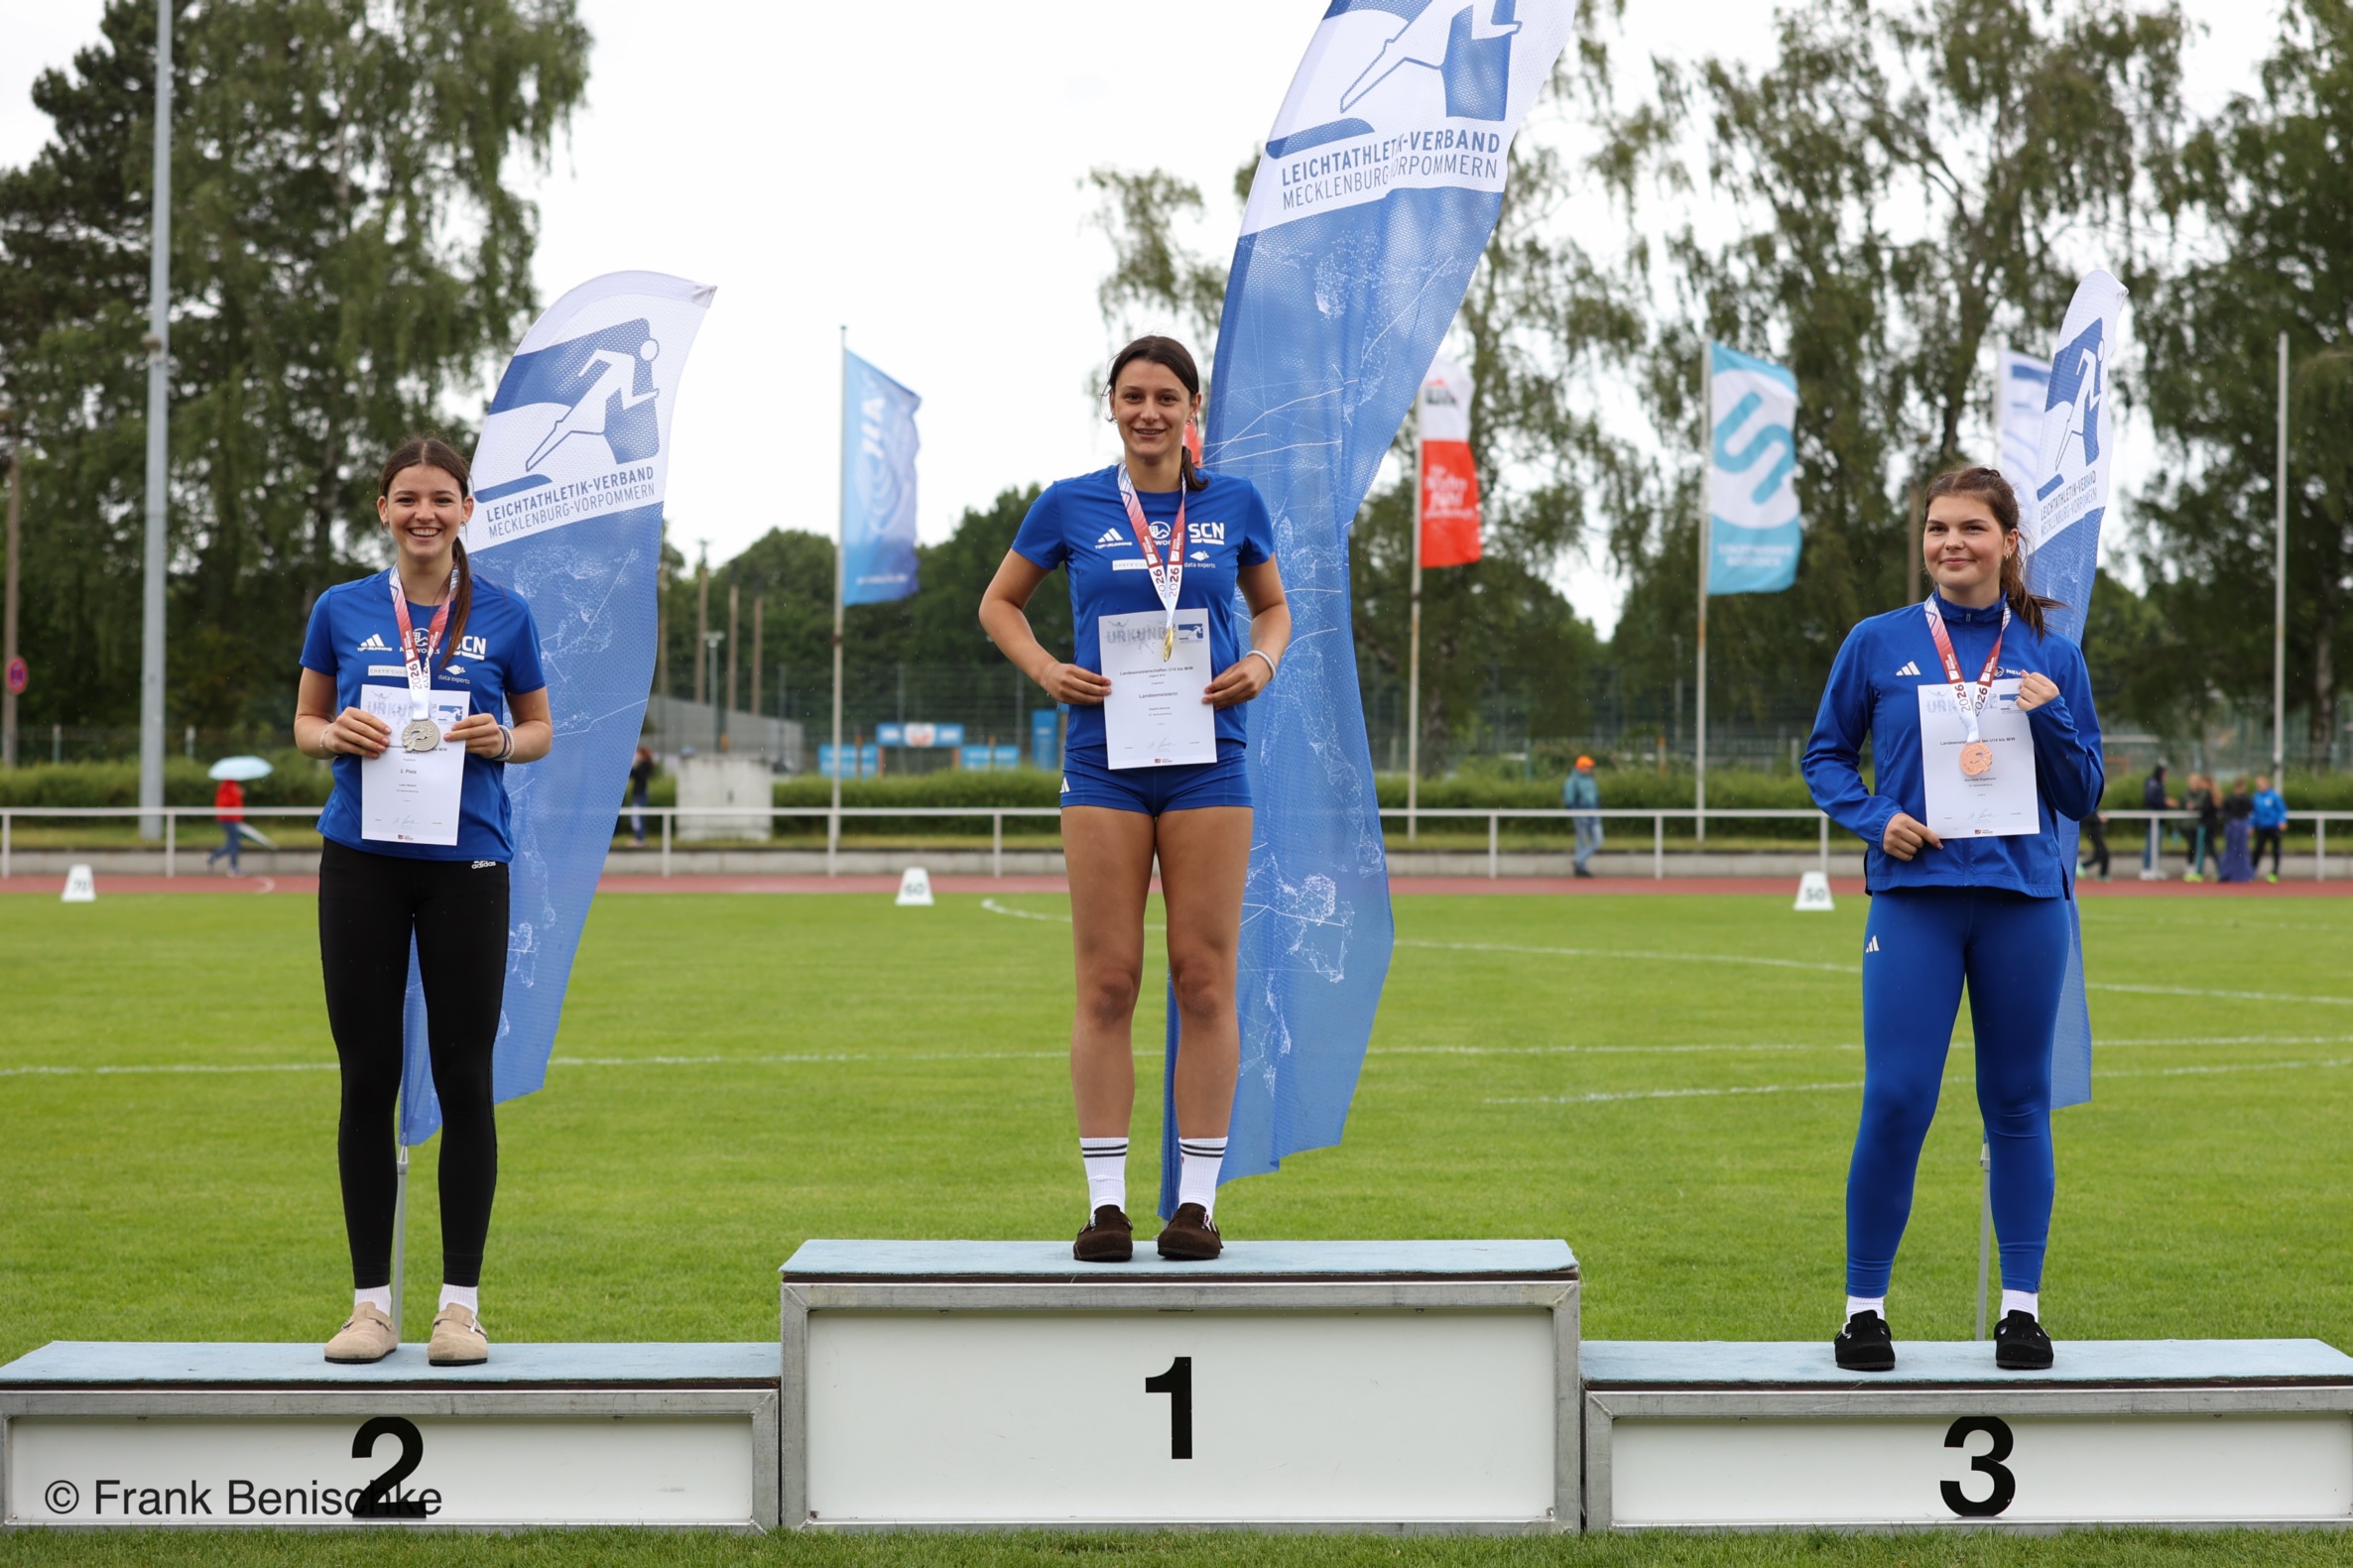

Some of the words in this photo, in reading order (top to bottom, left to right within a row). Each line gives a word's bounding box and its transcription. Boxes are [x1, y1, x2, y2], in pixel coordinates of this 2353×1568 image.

[486, 466, 654, 523] LEICHTATHLETIK-VERBAND
[488, 482, 656, 539] MECKLENBURG-VORPOMMERN
[1187, 522, 1225, 541] SCN
[1169, 567, 1180, 597] 2026
[451, 635, 486, 656] CN
[1106, 625, 1176, 644] URKUND
[409, 663, 423, 690] 2026
[451, 675, 470, 684] experts
[1954, 683, 1971, 713] 2026
[1974, 686, 1988, 717] 2026
[1145, 1357, 1193, 1460] 1
[351, 1416, 427, 1518] 2
[1939, 1415, 2016, 1517] 3
